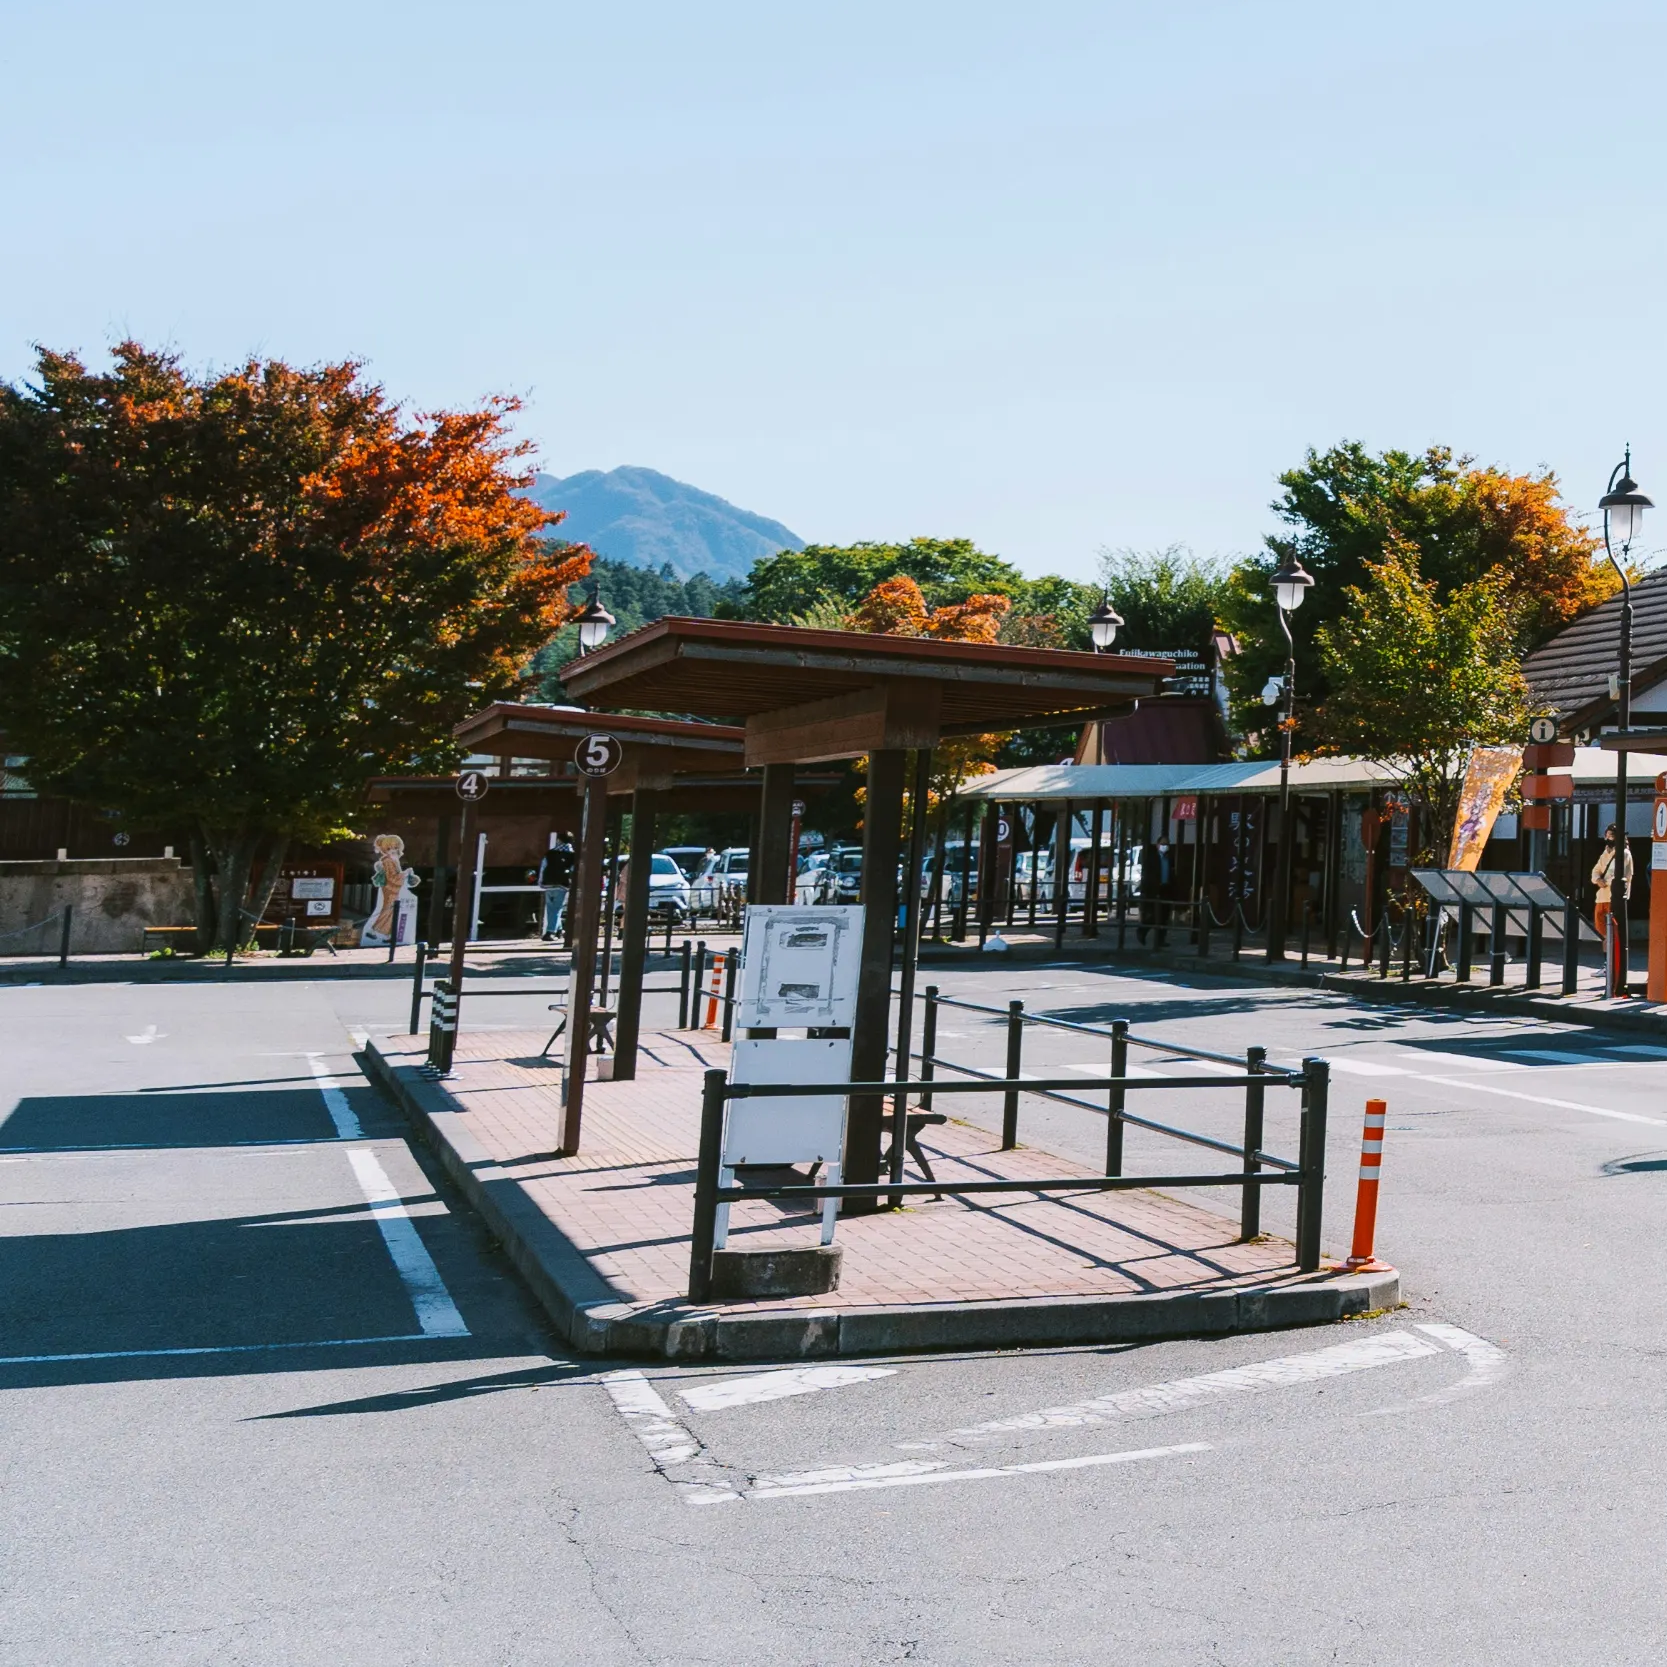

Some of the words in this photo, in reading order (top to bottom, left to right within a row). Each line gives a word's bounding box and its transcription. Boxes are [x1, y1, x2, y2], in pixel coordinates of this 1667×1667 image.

[1119, 648, 1199, 659] Fujikawaguchiko
[586, 736, 610, 766] 5
[462, 773, 478, 794] 4
